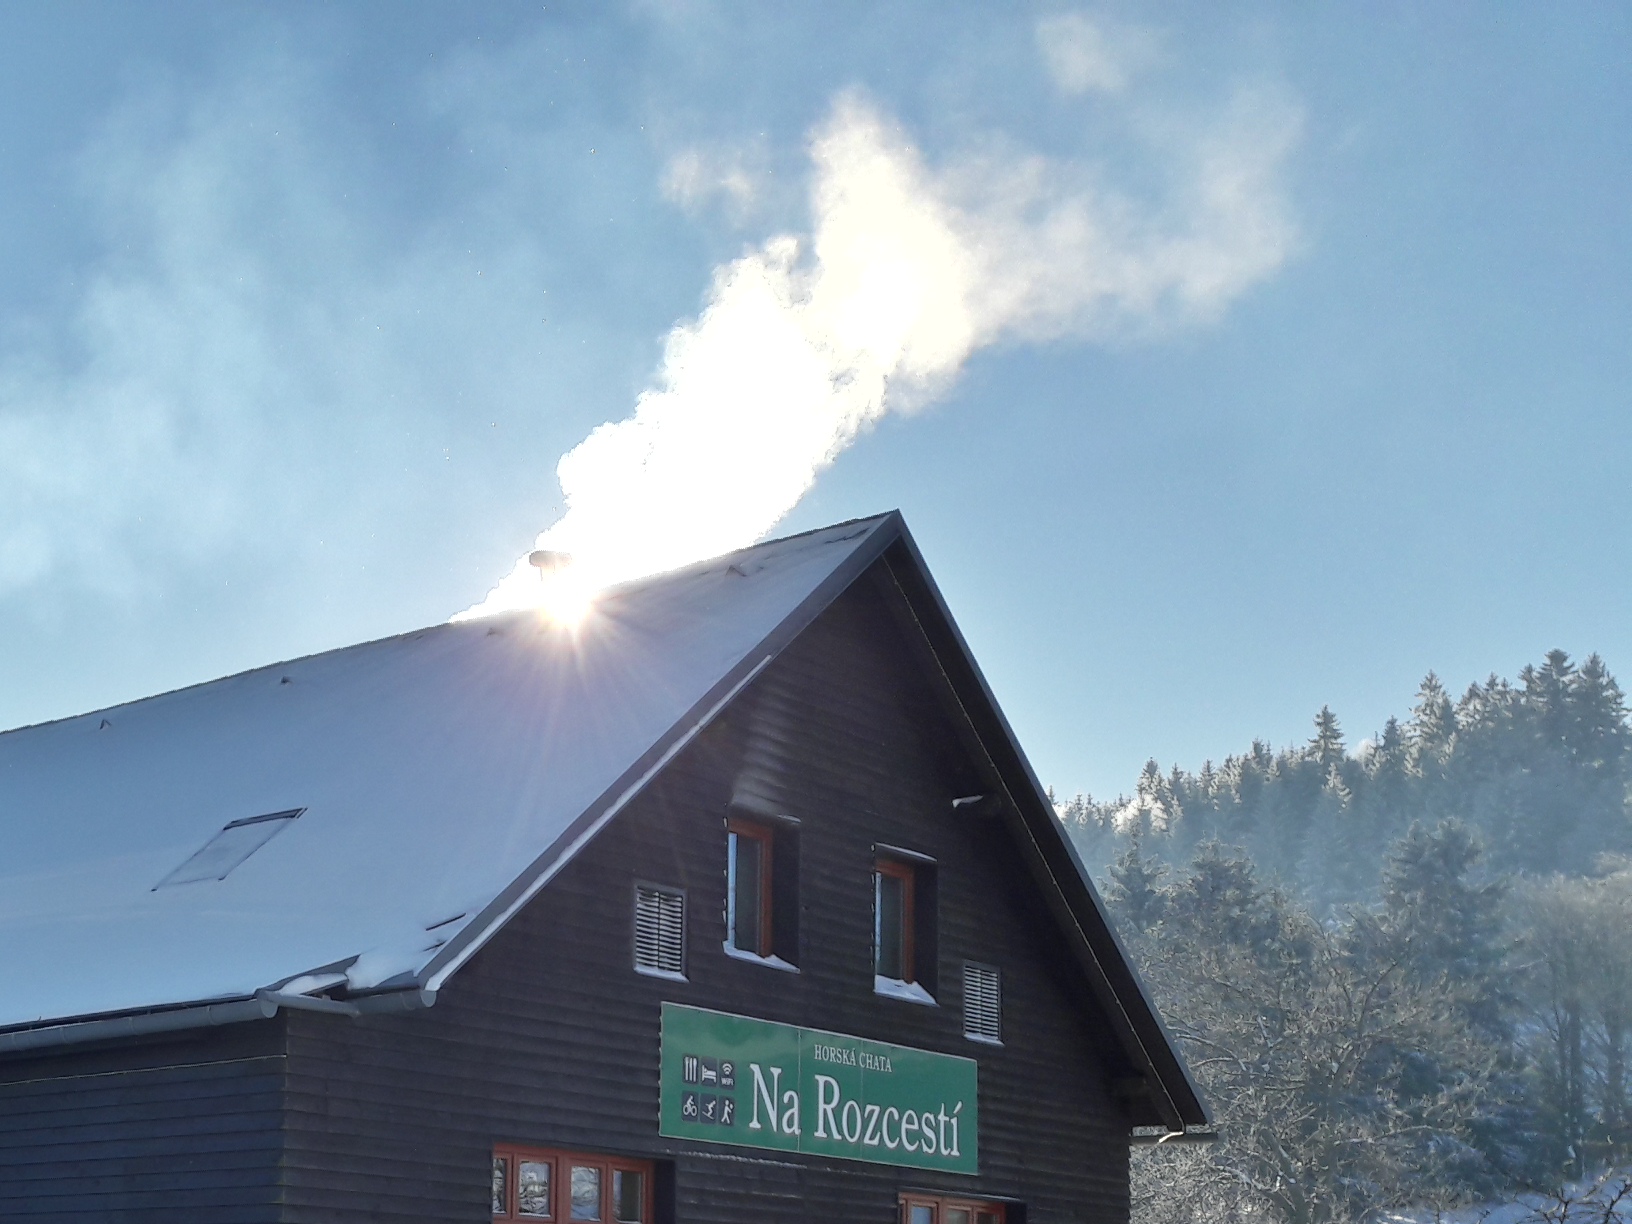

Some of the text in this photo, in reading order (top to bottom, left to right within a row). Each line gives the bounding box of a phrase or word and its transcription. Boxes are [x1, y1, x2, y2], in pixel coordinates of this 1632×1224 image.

[814, 1044, 892, 1073] HORSKÁ CHATA
[749, 1063, 963, 1157] Na Rozcestí
